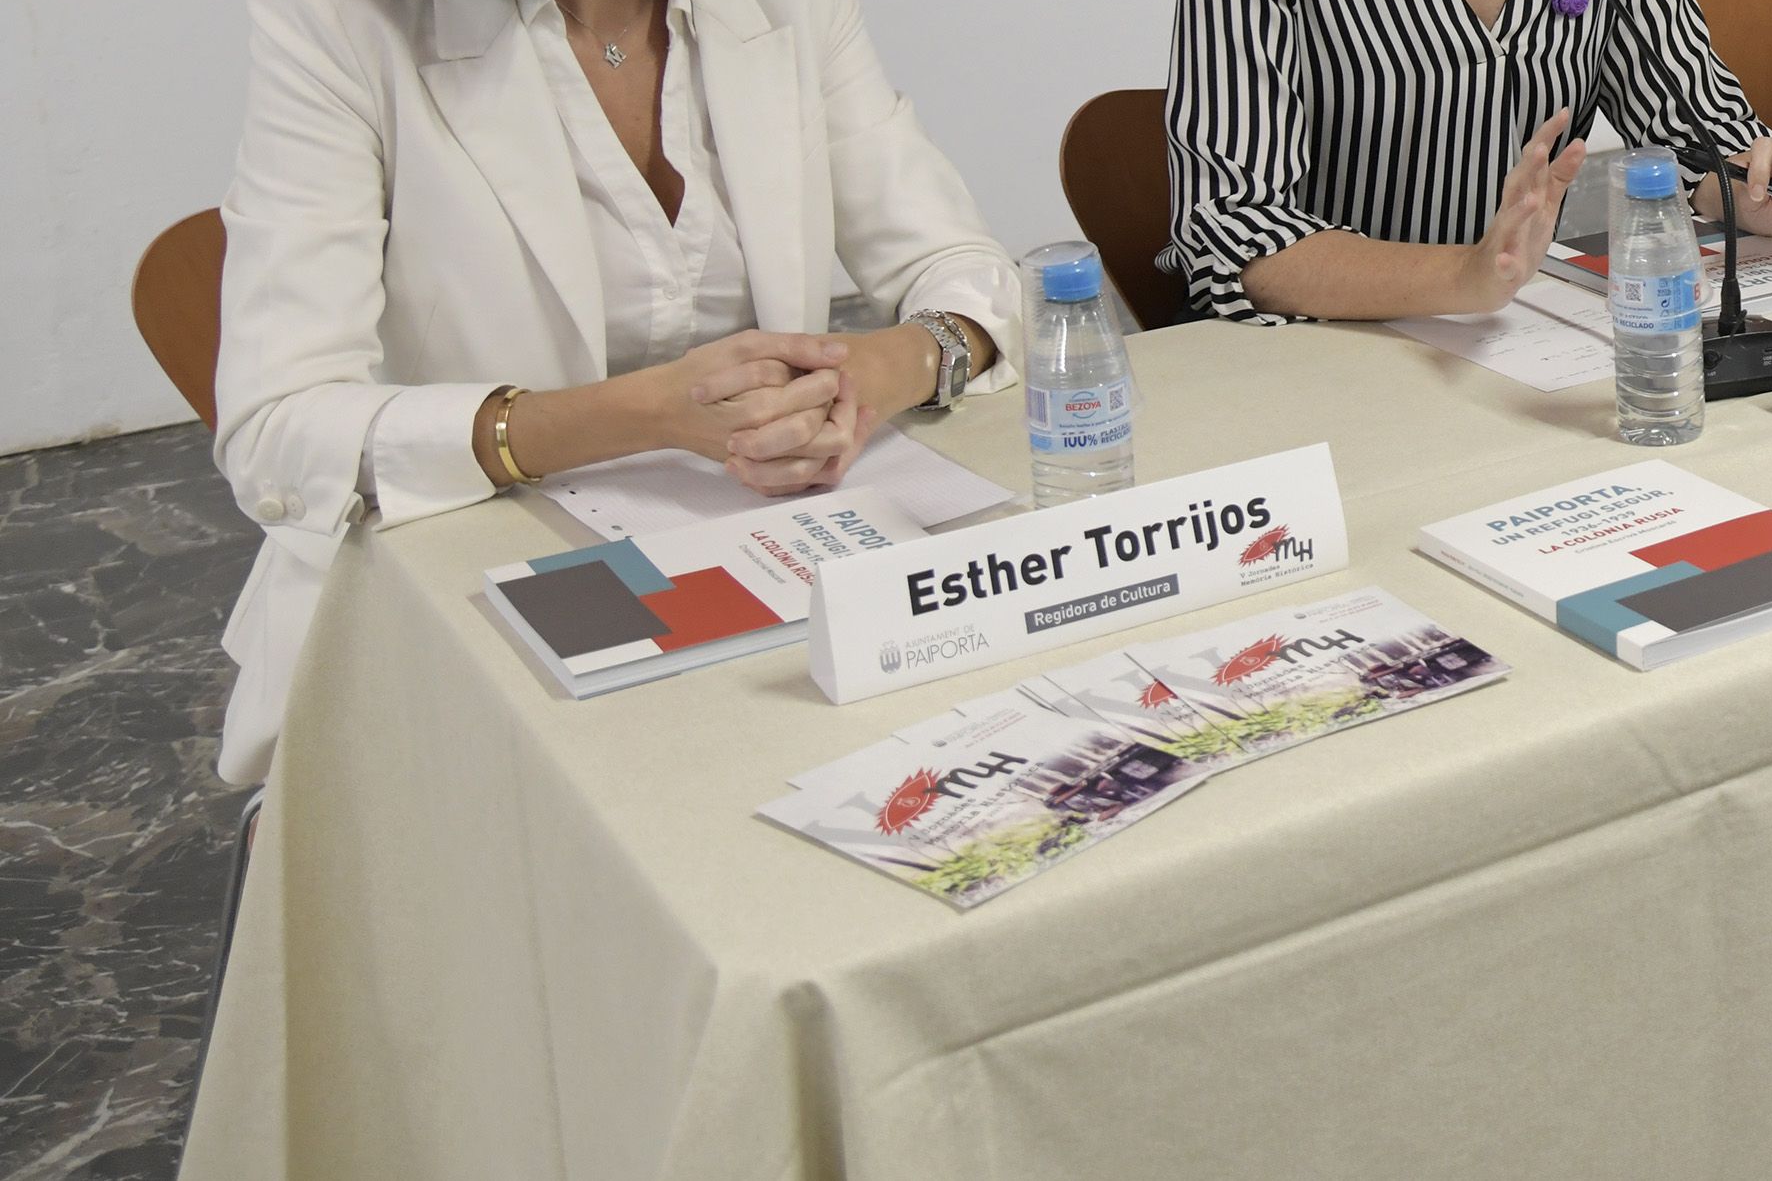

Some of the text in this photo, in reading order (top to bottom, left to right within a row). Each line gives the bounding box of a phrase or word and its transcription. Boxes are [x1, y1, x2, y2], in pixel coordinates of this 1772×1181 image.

[1065, 401, 1102, 412] BEZOYA
[792, 512, 815, 527] UN
[1486, 484, 1643, 532] PAIPORTA,
[1491, 489, 1675, 546] UN REFUGI SEGUR,
[1560, 510, 1637, 537] 1936-1939
[751, 530, 769, 541] LA
[1538, 544, 1565, 555] LA
[1634, 506, 1685, 526] RUSIA
[906, 496, 1272, 617] Esther Torrijos
[1248, 565, 1281, 577] Jornades
[1034, 580, 1171, 627] Regidora de Cultura
[906, 632, 990, 670] PAIPORTA
